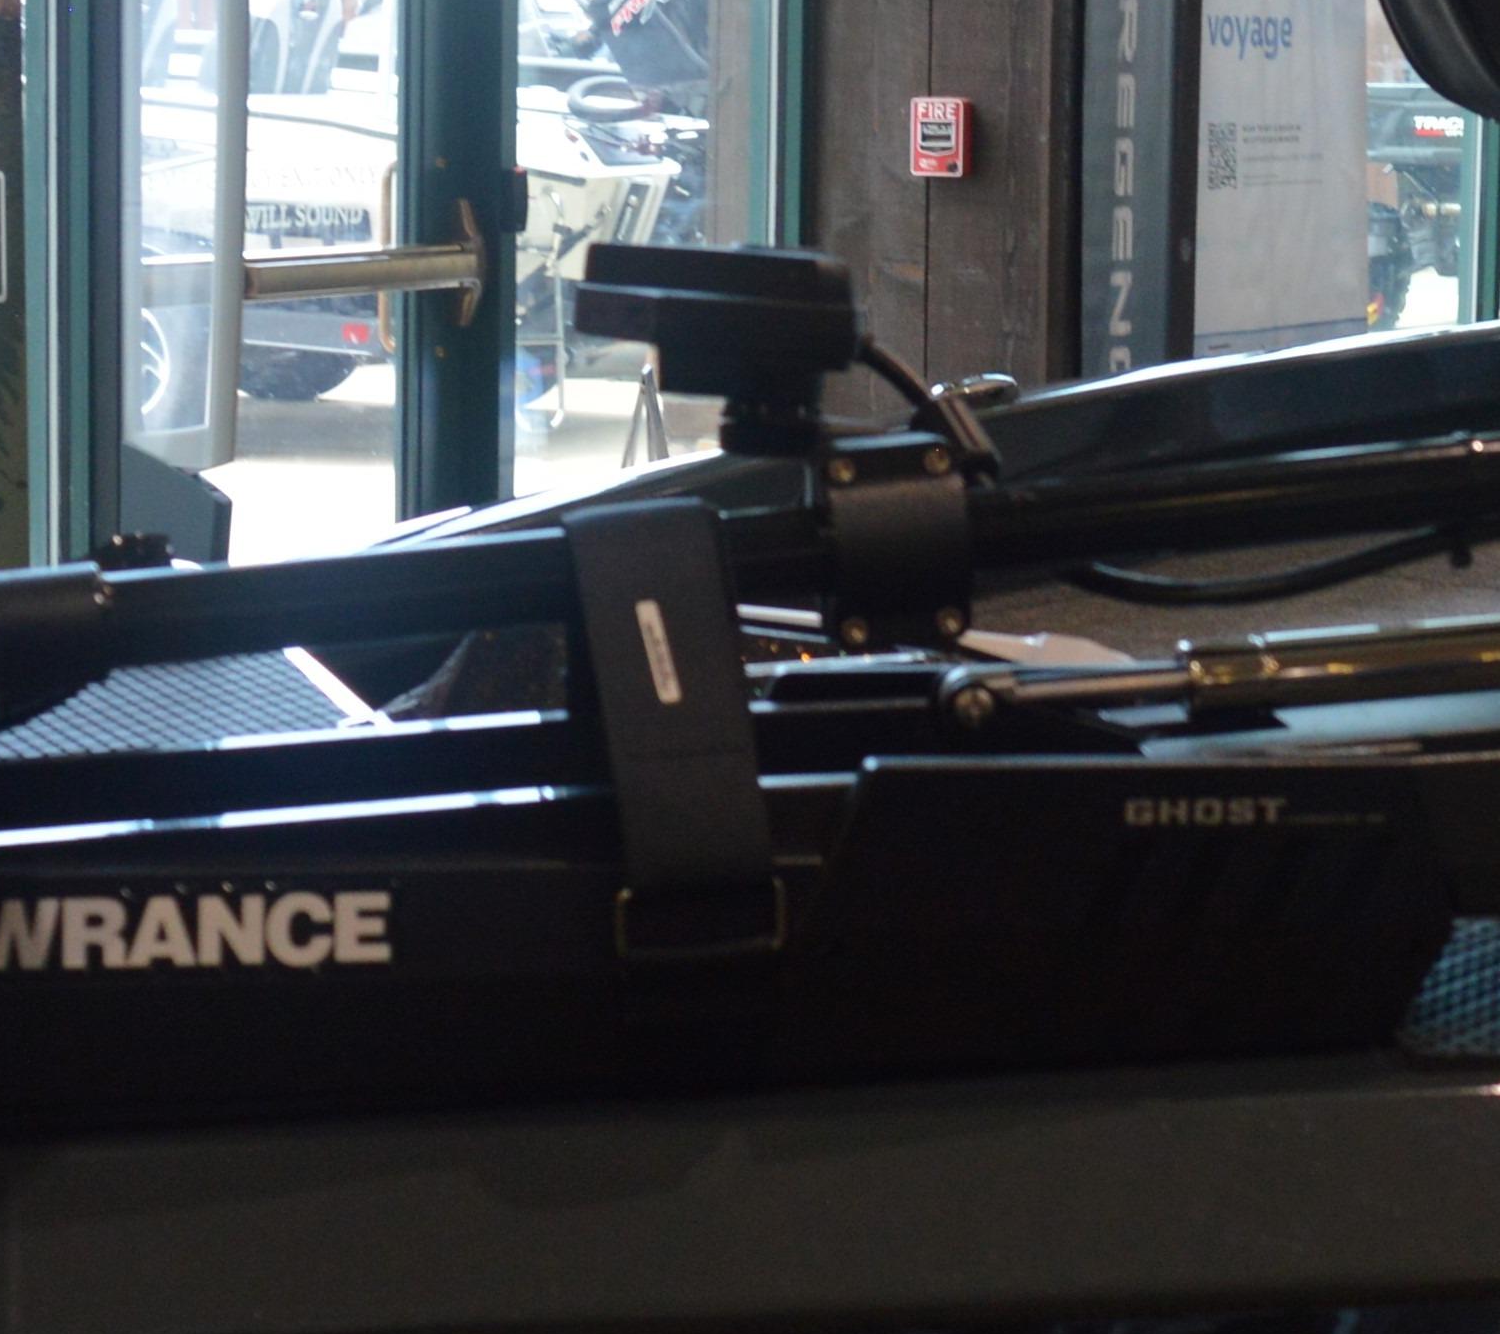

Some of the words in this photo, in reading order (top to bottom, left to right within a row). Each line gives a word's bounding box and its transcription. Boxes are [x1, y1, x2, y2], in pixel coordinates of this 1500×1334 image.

[1207, 13, 1293, 60] voyage
[917, 102, 958, 120] FIRE
[295, 204, 364, 228] SOUND
[1124, 797, 1285, 826] GHOST
